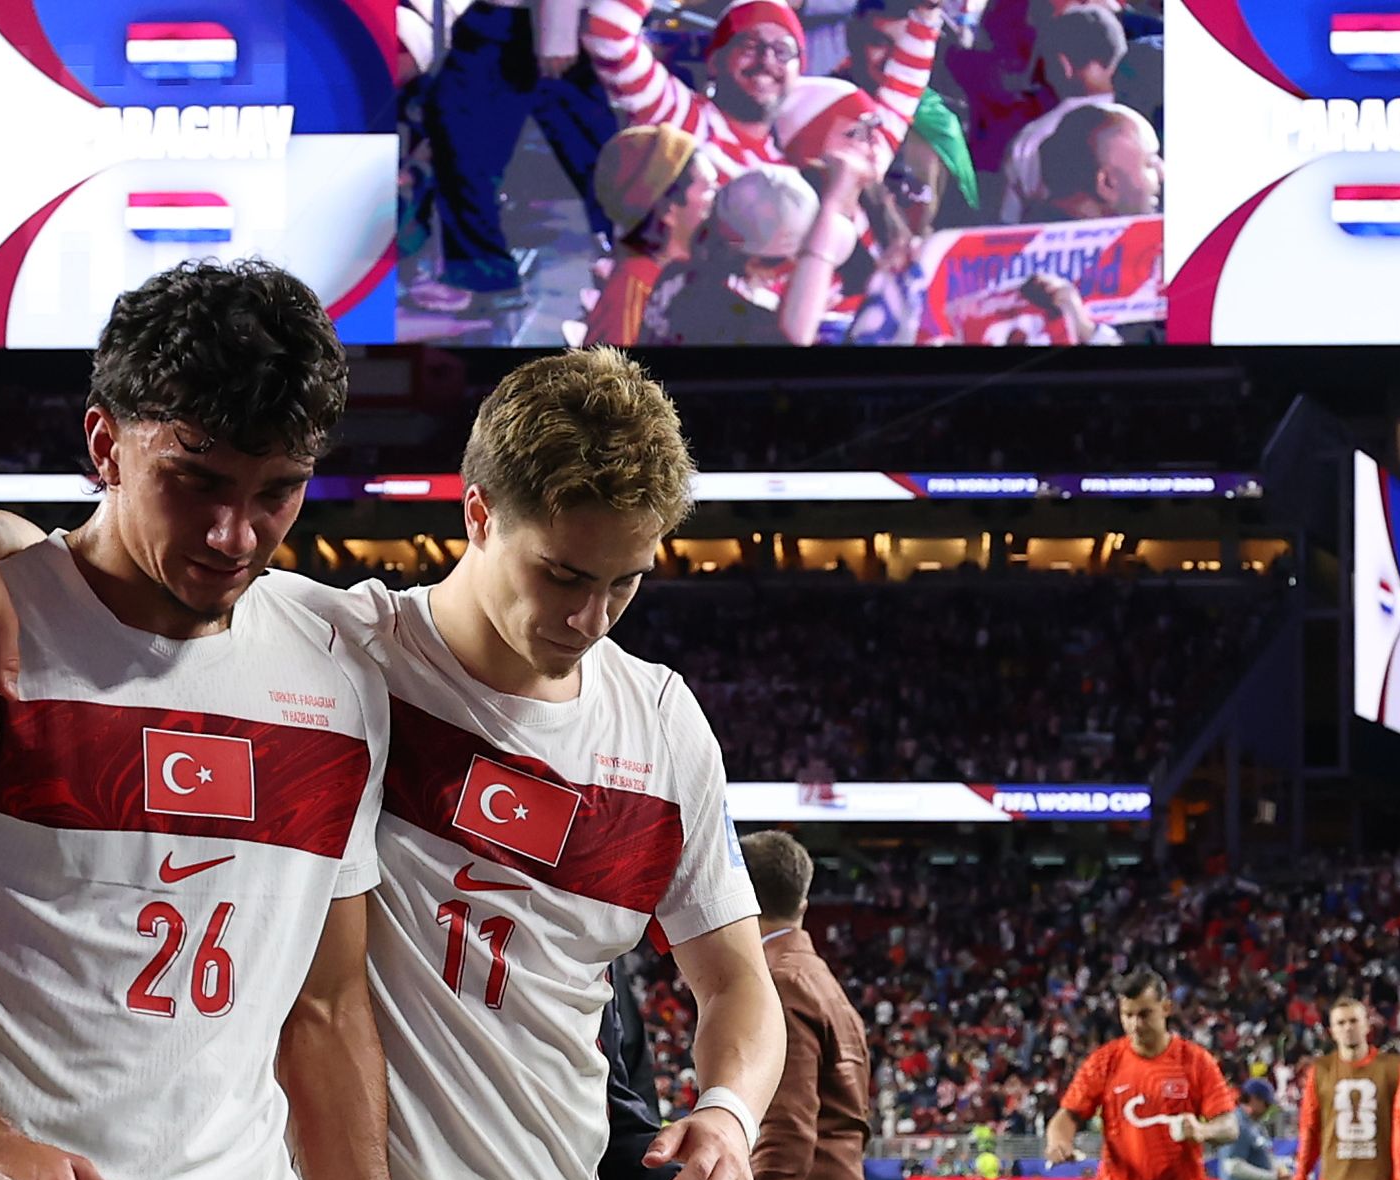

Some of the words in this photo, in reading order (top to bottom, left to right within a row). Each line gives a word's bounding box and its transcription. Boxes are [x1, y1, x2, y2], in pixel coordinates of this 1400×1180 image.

[86, 105, 295, 159] ARAGUAY
[1036, 792, 1109, 812] WORLD
[1108, 792, 1151, 812] CUP
[126, 900, 234, 1018] 26
[436, 898, 514, 1010] 11
